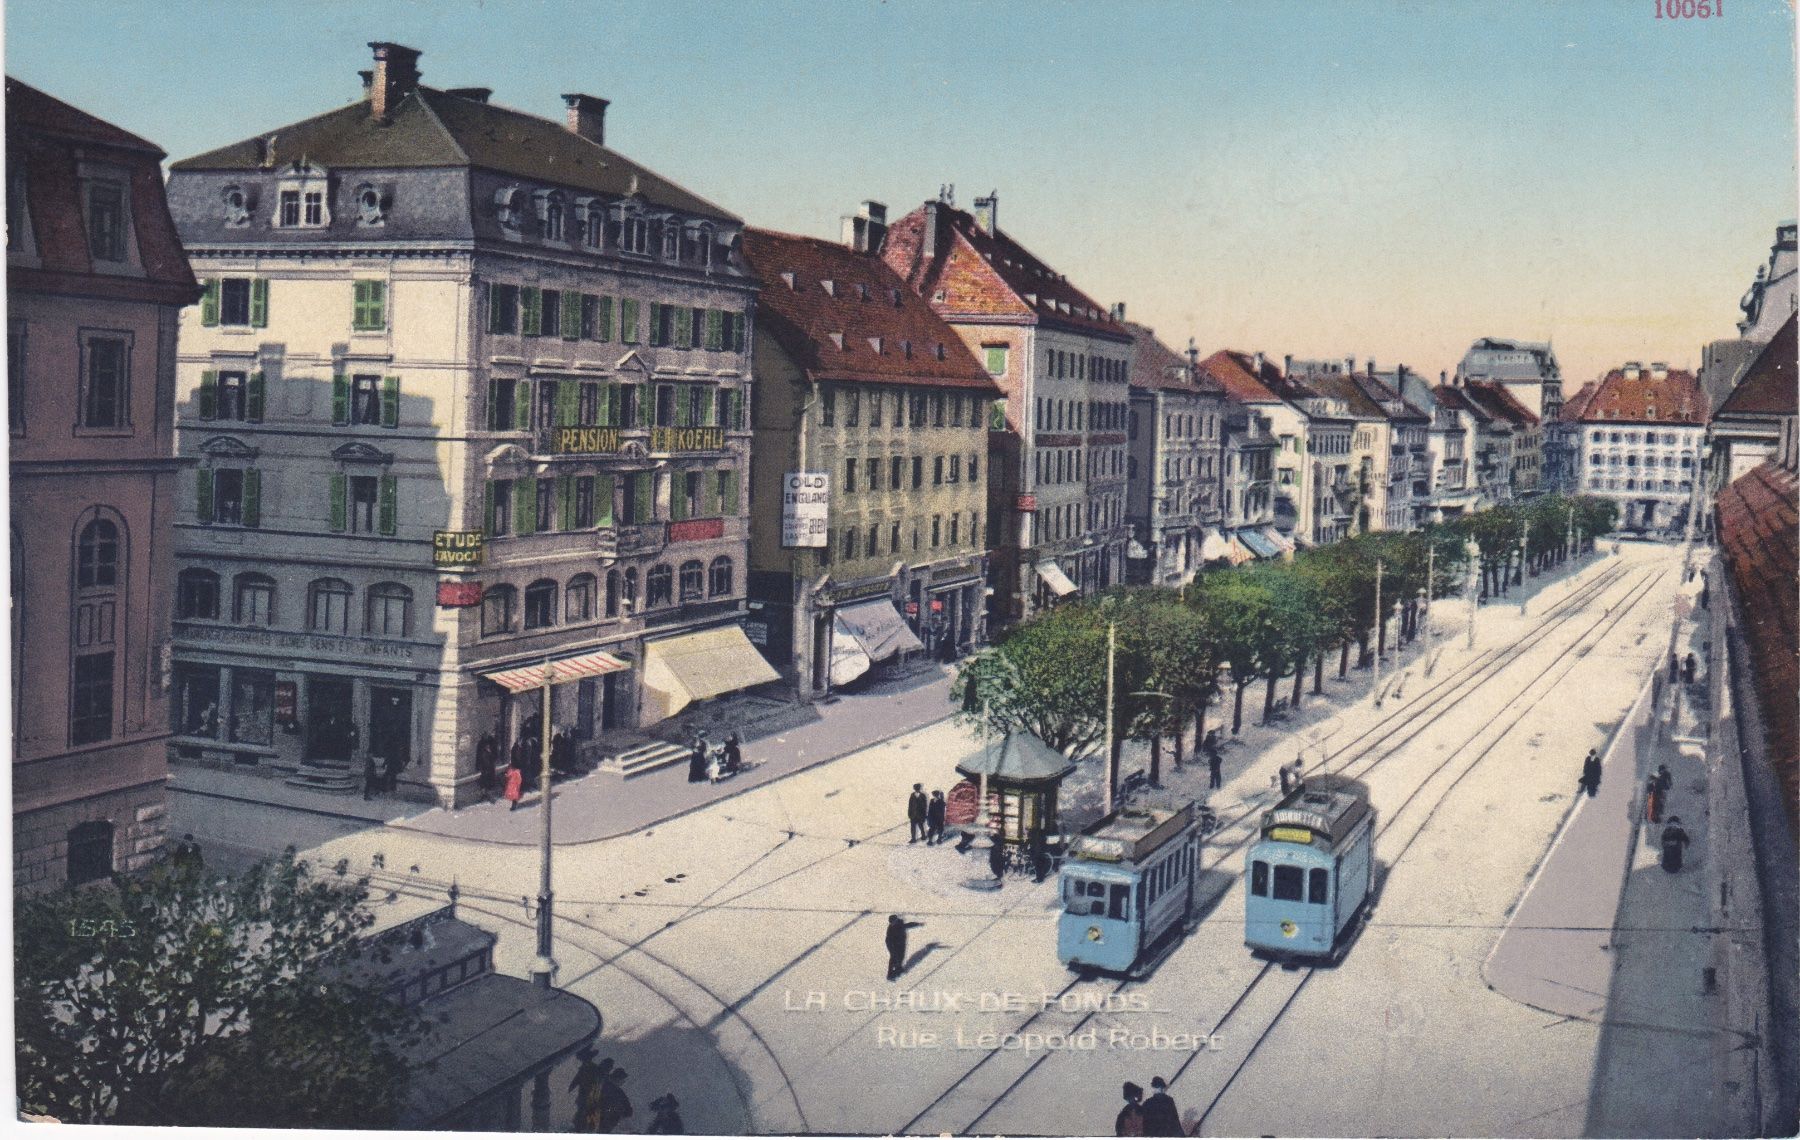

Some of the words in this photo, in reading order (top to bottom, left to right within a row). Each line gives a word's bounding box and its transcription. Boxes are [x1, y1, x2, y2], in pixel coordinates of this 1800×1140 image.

[560, 428, 618, 453] PENSION
[789, 475, 826, 489] OLD
[784, 492, 828, 505] ENGLAND
